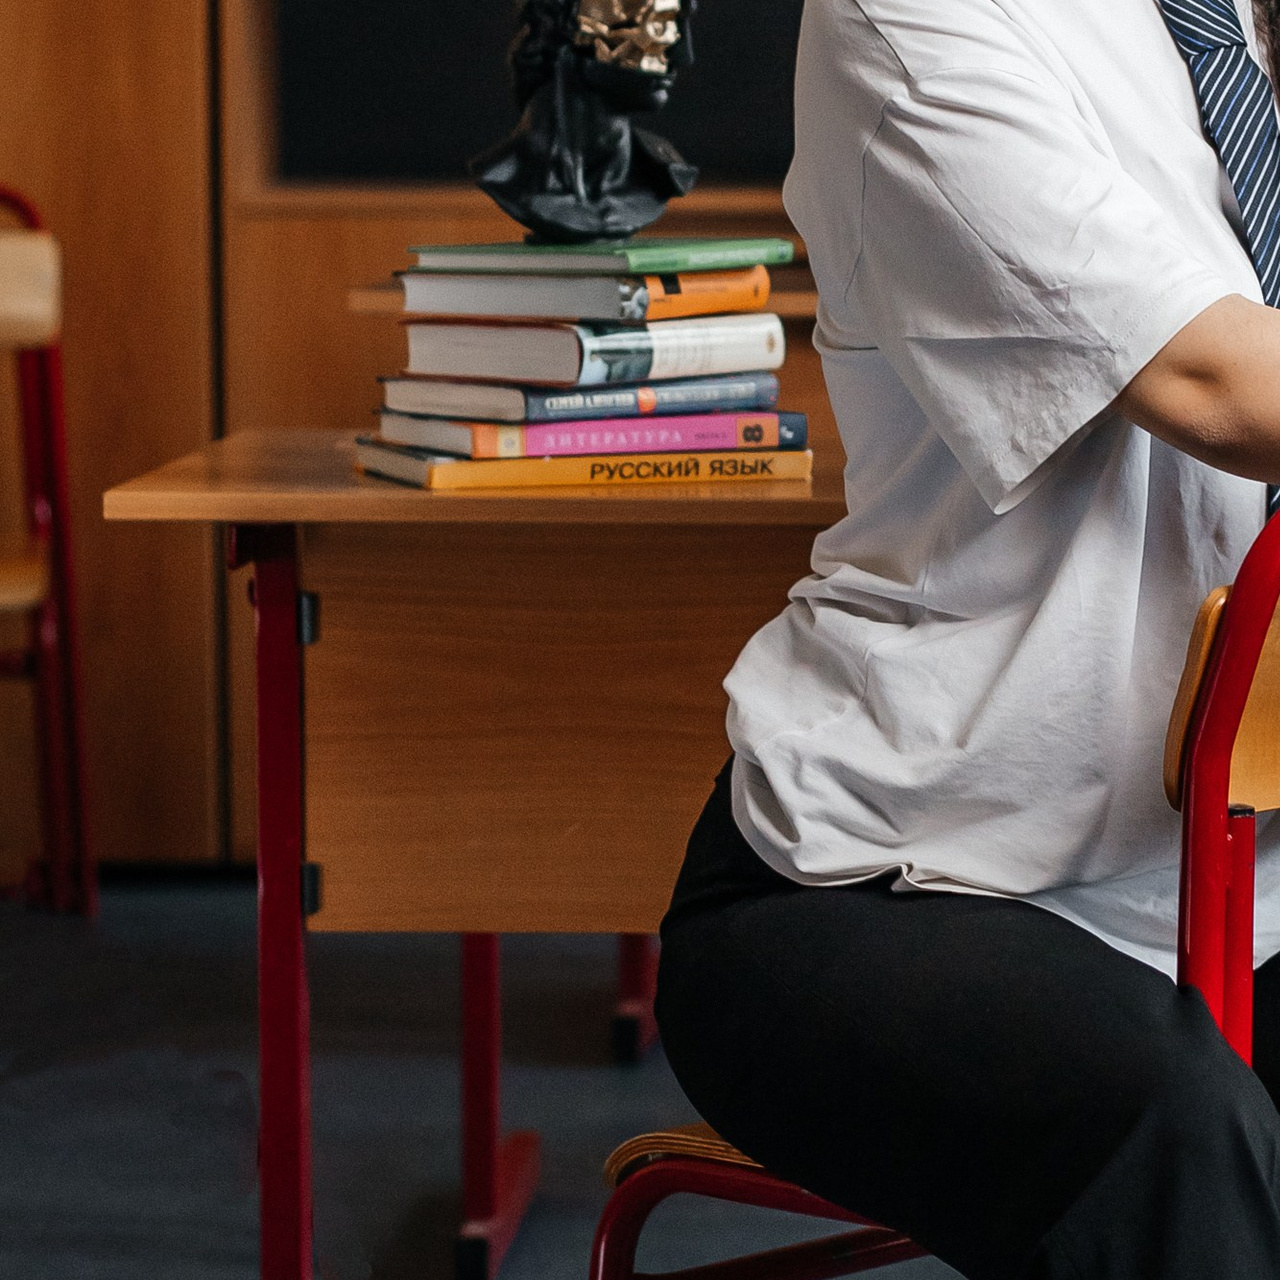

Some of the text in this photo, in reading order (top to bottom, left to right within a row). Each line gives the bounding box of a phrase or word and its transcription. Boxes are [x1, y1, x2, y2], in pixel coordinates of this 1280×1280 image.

[545, 430, 683, 449] ЛИТЕРАТУРА
[590, 457, 774, 480] РУССКИЙ ЯЗЫК
